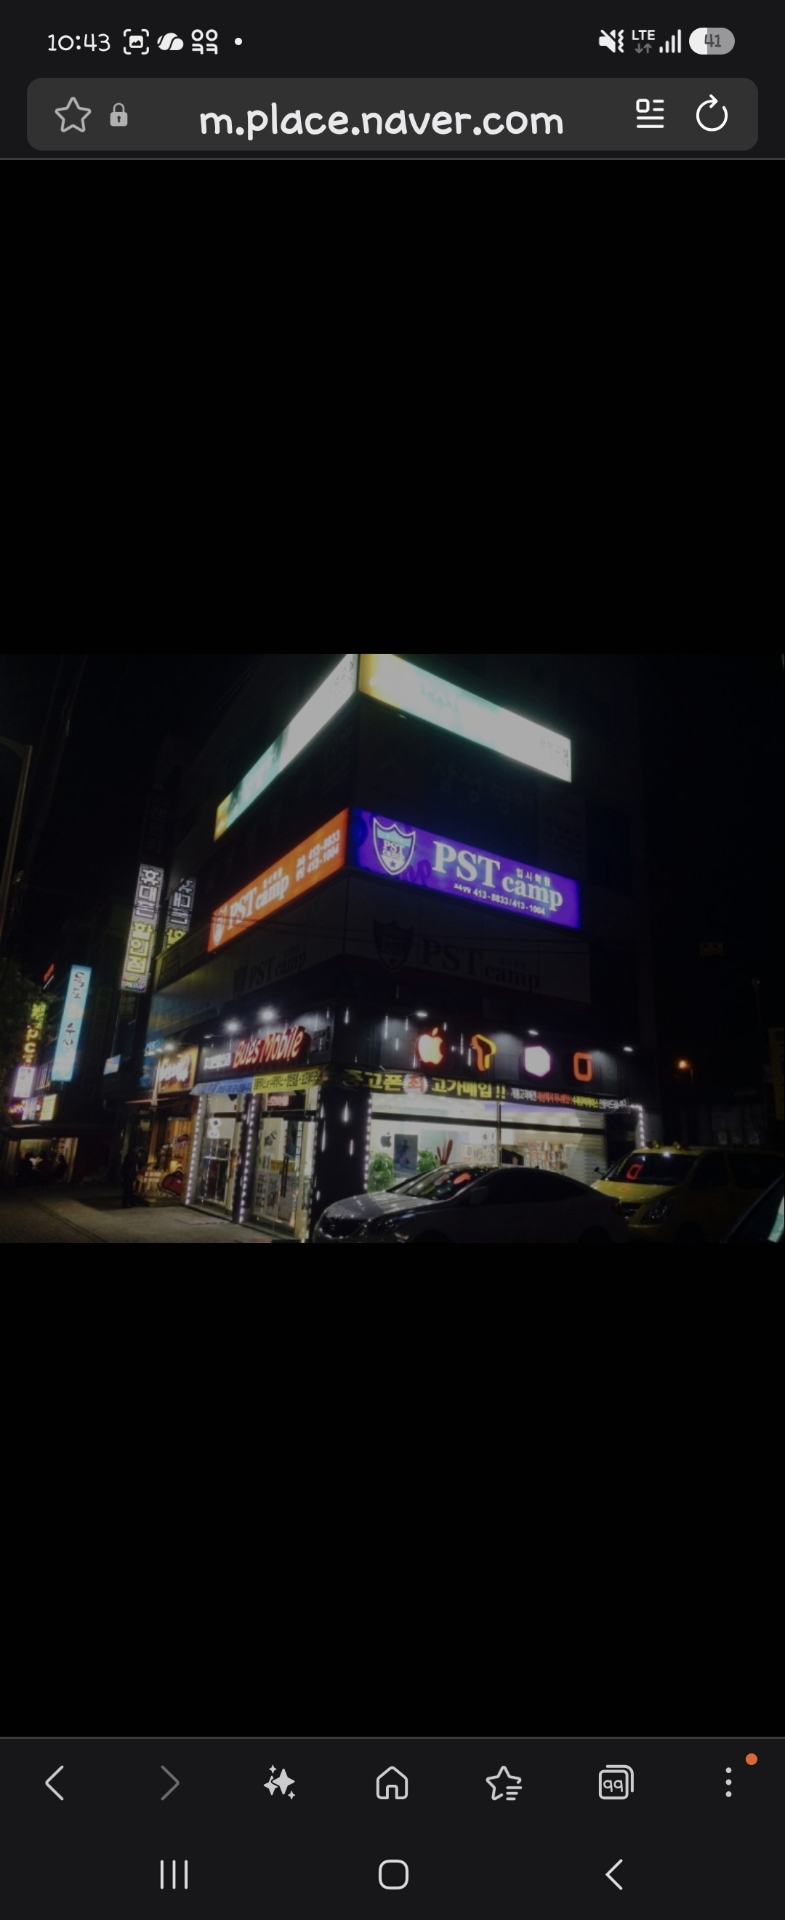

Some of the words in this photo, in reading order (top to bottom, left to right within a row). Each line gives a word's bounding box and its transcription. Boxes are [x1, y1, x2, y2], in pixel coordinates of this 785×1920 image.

[47, 32, 111, 53] 10:43
[631, 29, 656, 41] LTE
[704, 33, 722, 48] 41
[199, 102, 564, 141] m.place.naver.com
[382, 839, 405, 854] PST
[134, 868, 160, 920] 휴대폰
[432, 841, 501, 888] PST
[502, 874, 563, 912] camp
[227, 886, 257, 930] PST
[256, 874, 290, 910] camp
[126, 921, 154, 974] 할인점
[420, 937, 482, 976] PST
[484, 961, 541, 993] camp
[259, 1025, 305, 1063] Mobile
[342, 1067, 403, 1093] 중고폰
[431, 1076, 493, 1099] 고가매입
